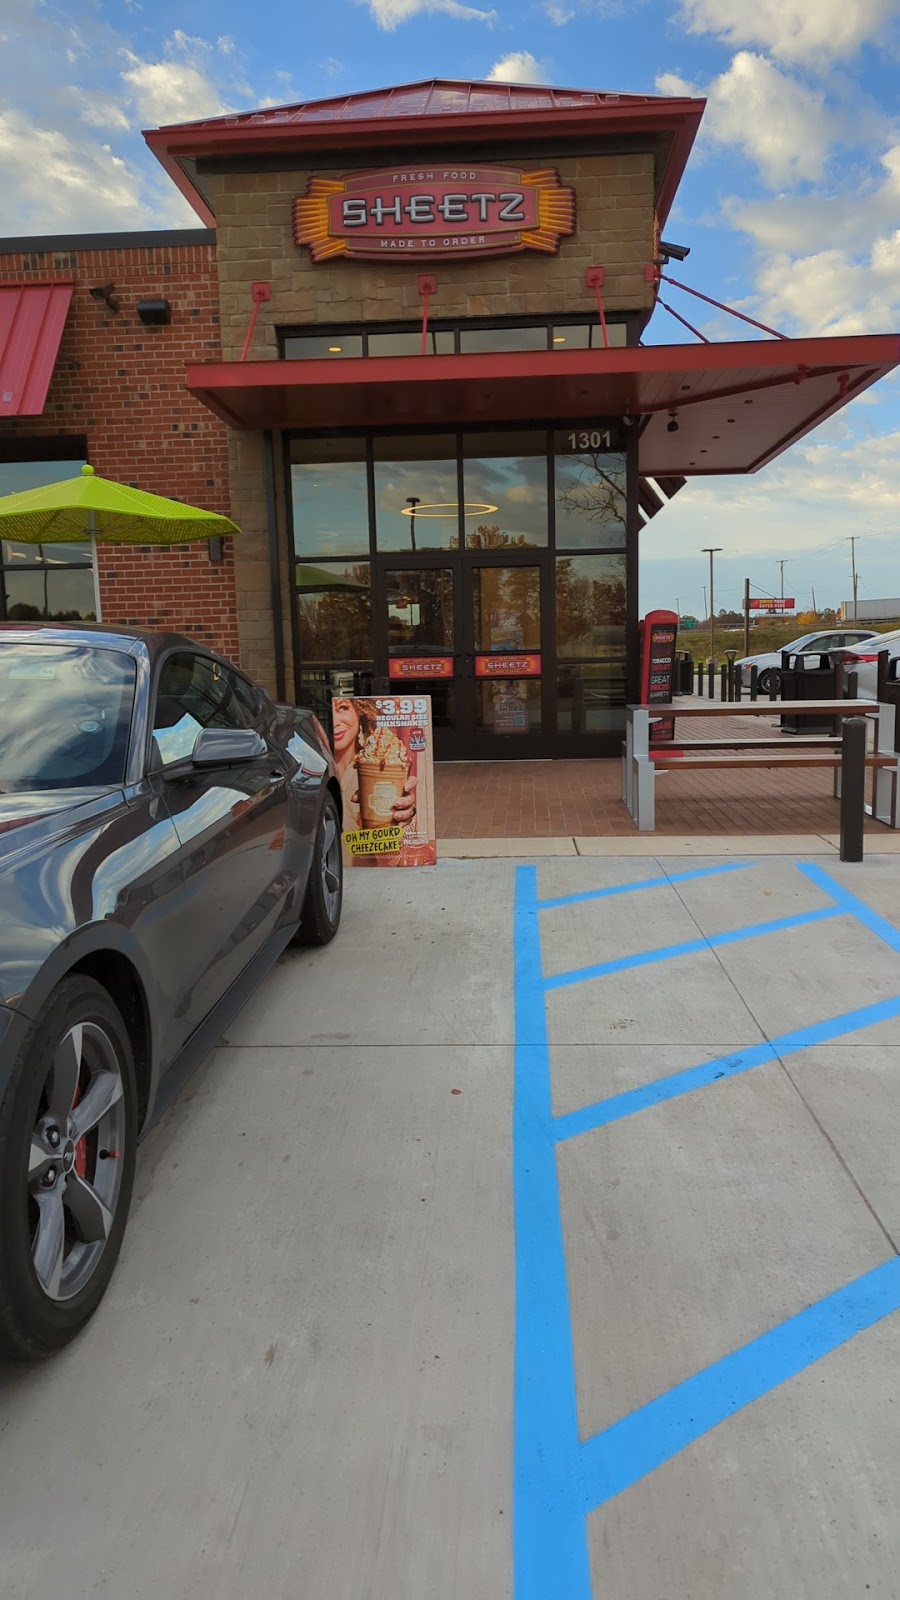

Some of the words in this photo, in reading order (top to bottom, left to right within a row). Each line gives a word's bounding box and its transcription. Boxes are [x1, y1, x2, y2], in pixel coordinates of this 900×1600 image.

[392, 172, 434, 182] FRESH
[443, 171, 477, 180] FOOD
[342, 193, 524, 227] SHEETZ
[380, 239, 415, 248] MADE
[421, 239, 436, 247] TO
[443, 235, 486, 246] ORDER
[568, 430, 611, 449] 1301
[487, 661, 528, 669] SHEETZ
[650, 675, 671, 685] GREAT
[375, 699, 427, 715] $3.99
[345, 833, 358, 843] OH
[359, 829, 370, 841] MY
[372, 827, 401, 840] GOURD
[351, 840, 397, 853] CHEEZECAKE
